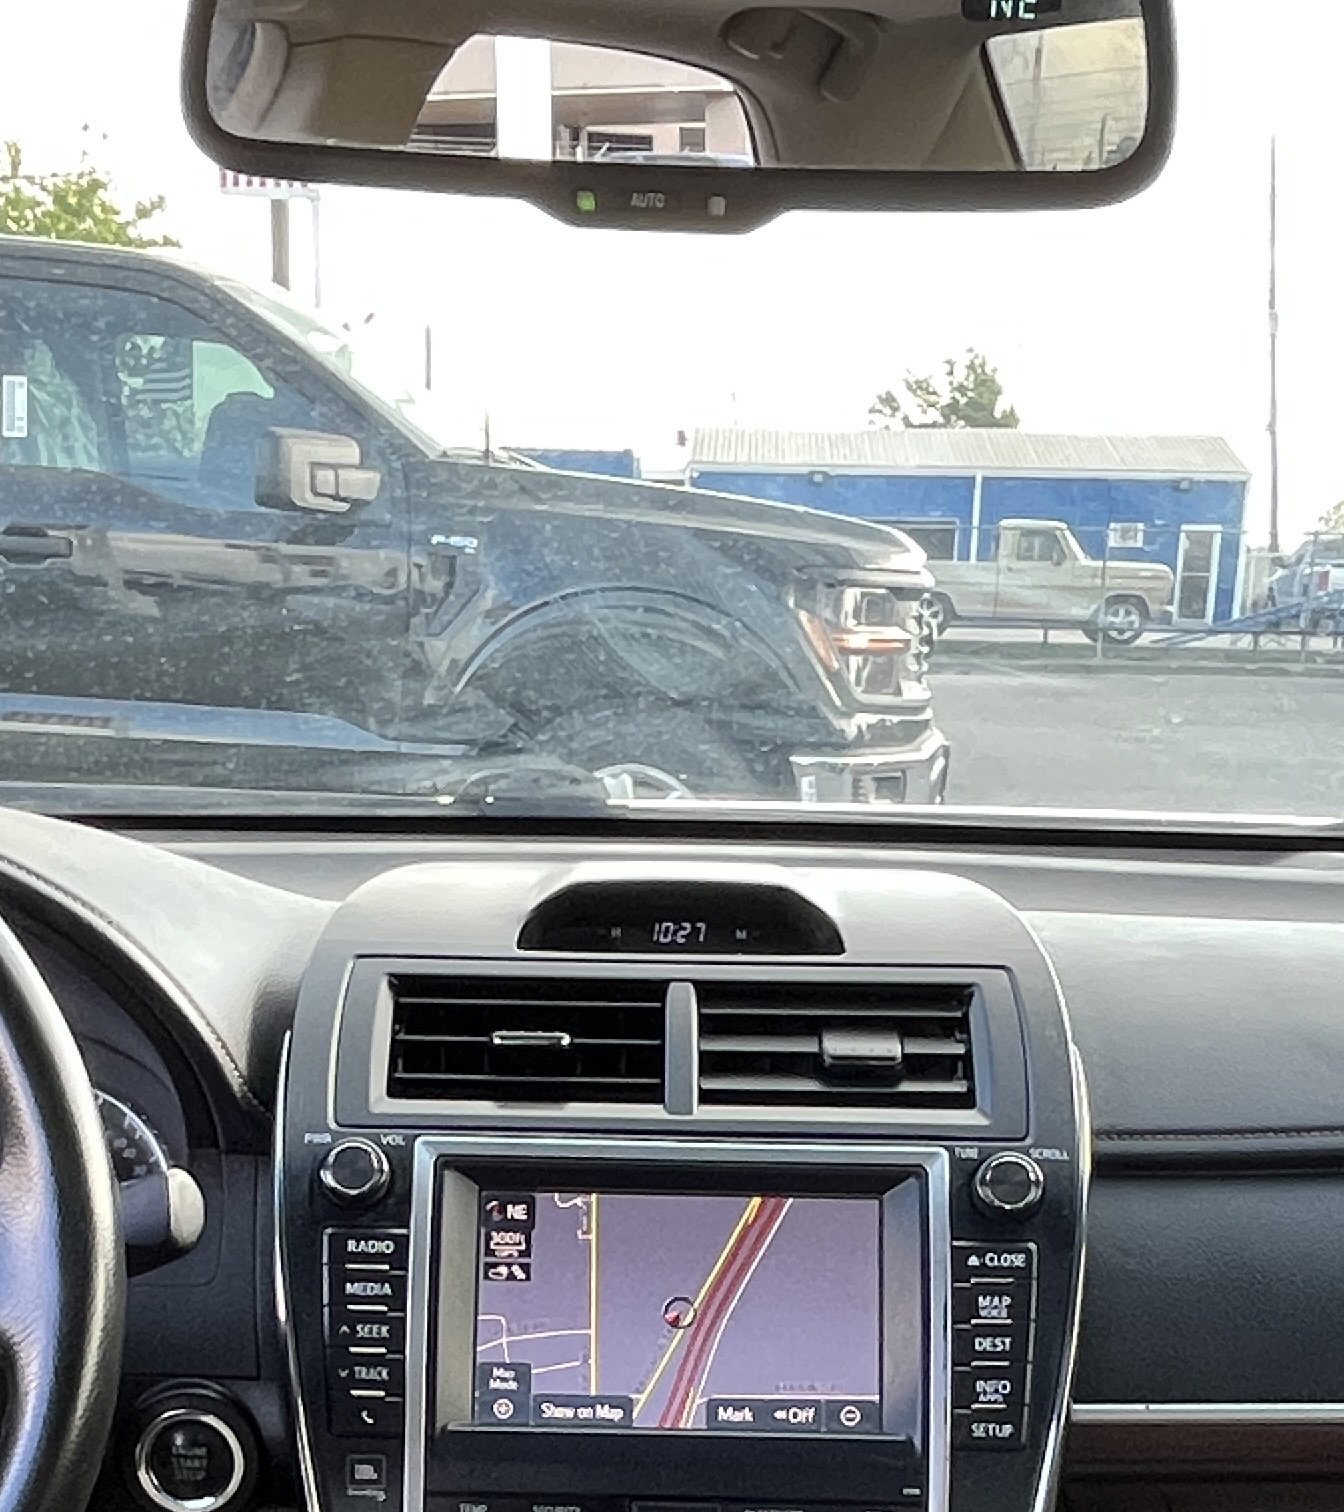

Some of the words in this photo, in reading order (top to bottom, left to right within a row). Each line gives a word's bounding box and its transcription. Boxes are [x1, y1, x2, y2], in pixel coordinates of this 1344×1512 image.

[630, 192, 666, 208] AUTO
[652, 922, 706, 943] 10:27
[380, 1134, 406, 1146] VOL
[506, 1204, 528, 1220] NE
[346, 1239, 395, 1254] RADIO
[984, 1252, 1026, 1268] CLOSE
[344, 1282, 393, 1296] MEDIA
[978, 1295, 1012, 1308] MAP
[356, 1323, 390, 1338] SEEK
[974, 1336, 1012, 1352] DEST
[354, 1366, 390, 1381] TRACK
[976, 1380, 1012, 1394] INFO
[540, 1402, 575, 1419] Show
[576, 1406, 594, 1419] on
[595, 1404, 624, 1422] Map
[717, 1406, 754, 1422] Mark
[788, 1407, 816, 1424] Off
[970, 1422, 1014, 1438] SETUP
